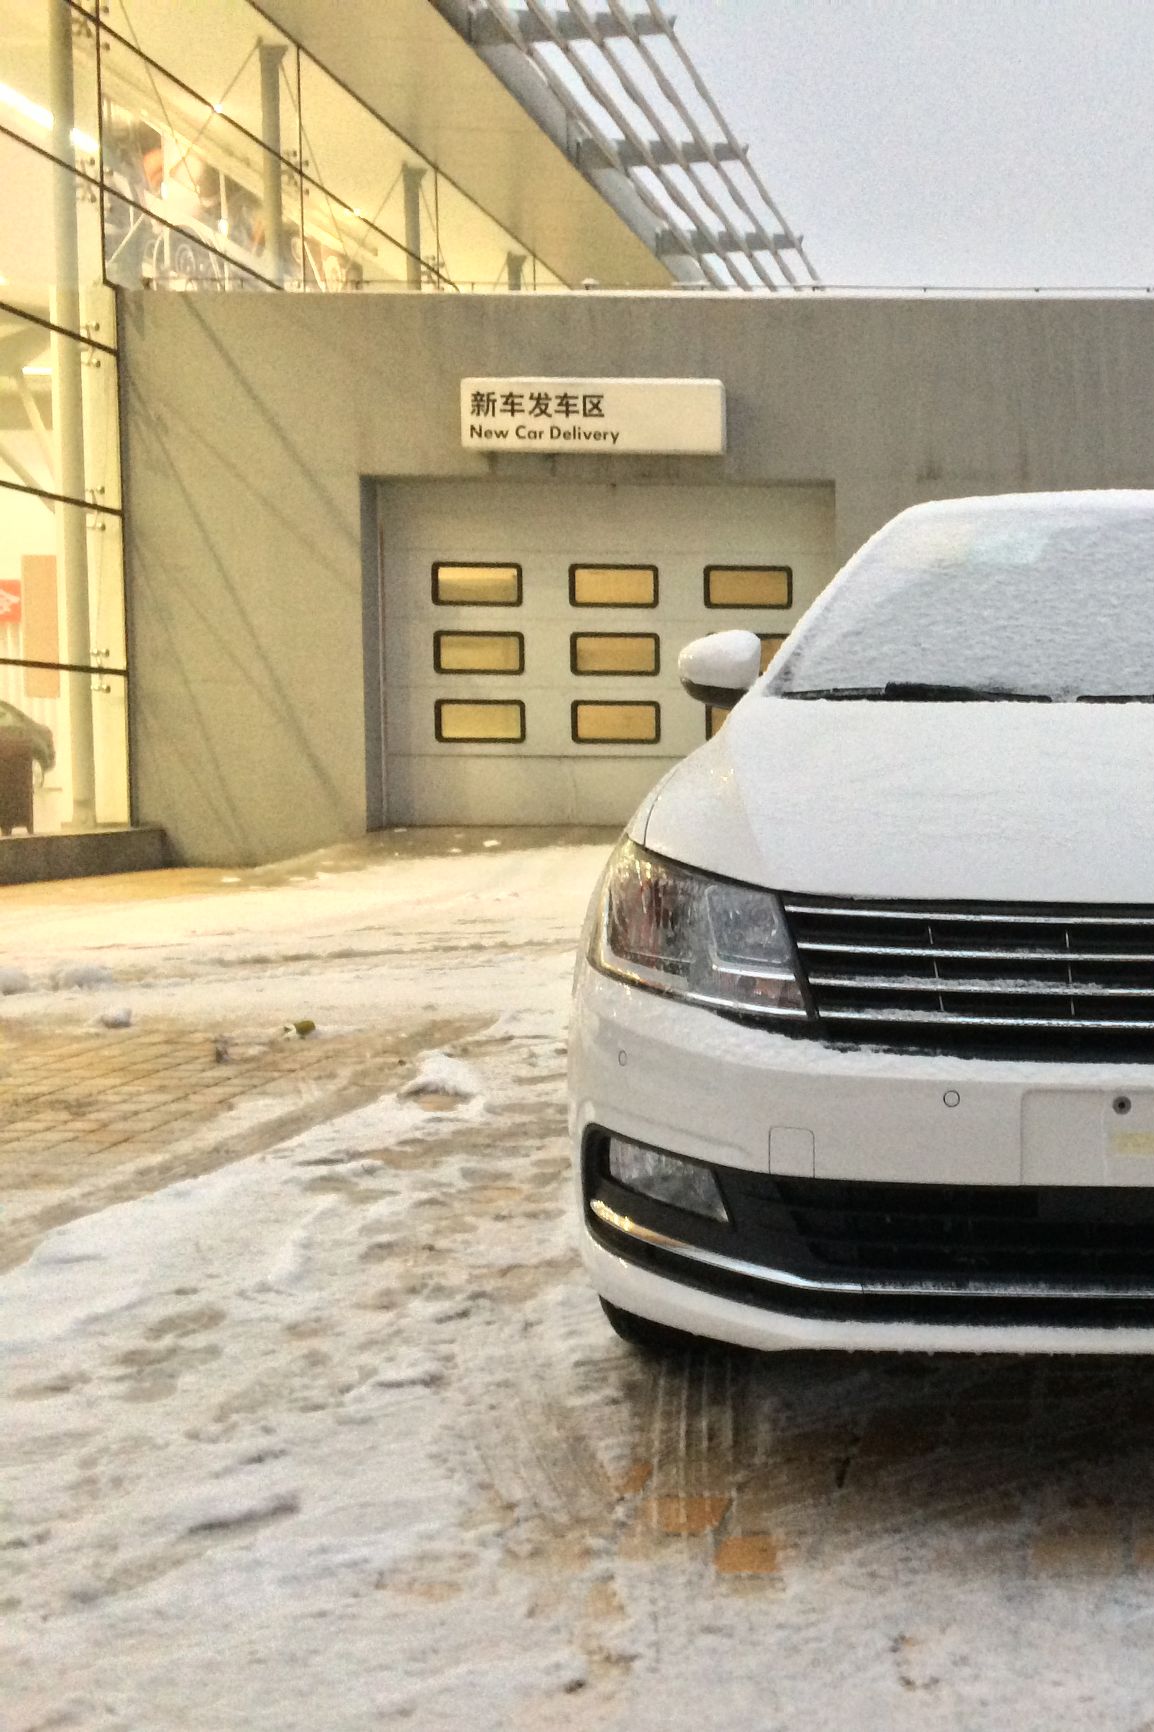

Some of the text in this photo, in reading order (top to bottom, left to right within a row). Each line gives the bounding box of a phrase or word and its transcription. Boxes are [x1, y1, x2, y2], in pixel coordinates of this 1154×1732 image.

[470, 391, 605, 418] 新车发车区
[470, 424, 620, 444] New Car Delivery
